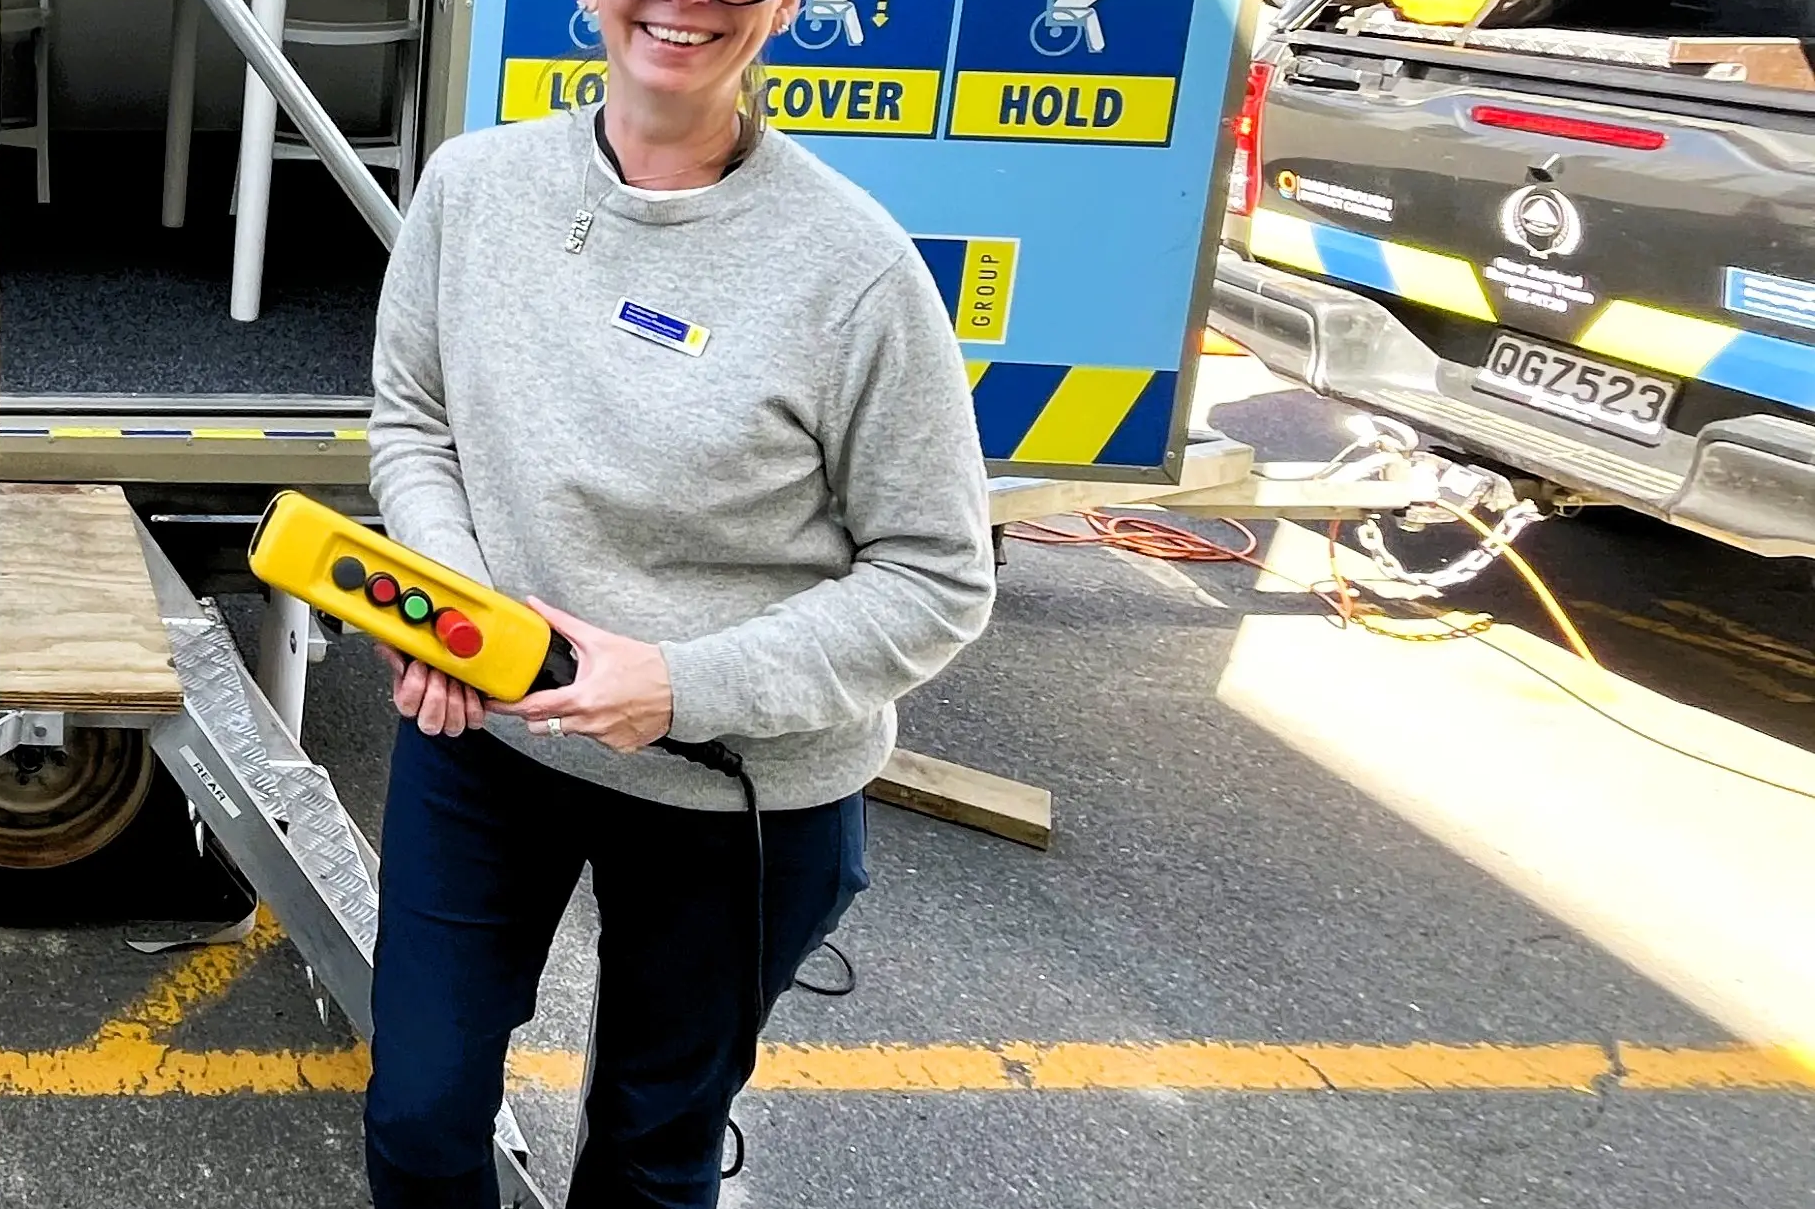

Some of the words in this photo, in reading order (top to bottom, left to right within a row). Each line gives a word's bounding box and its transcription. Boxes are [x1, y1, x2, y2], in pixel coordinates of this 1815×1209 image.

[999, 84, 1124, 128] HOLD
[971, 254, 1000, 327] GROUP
[1490, 341, 1668, 422] QGZ523
[193, 762, 226, 801] REAR
